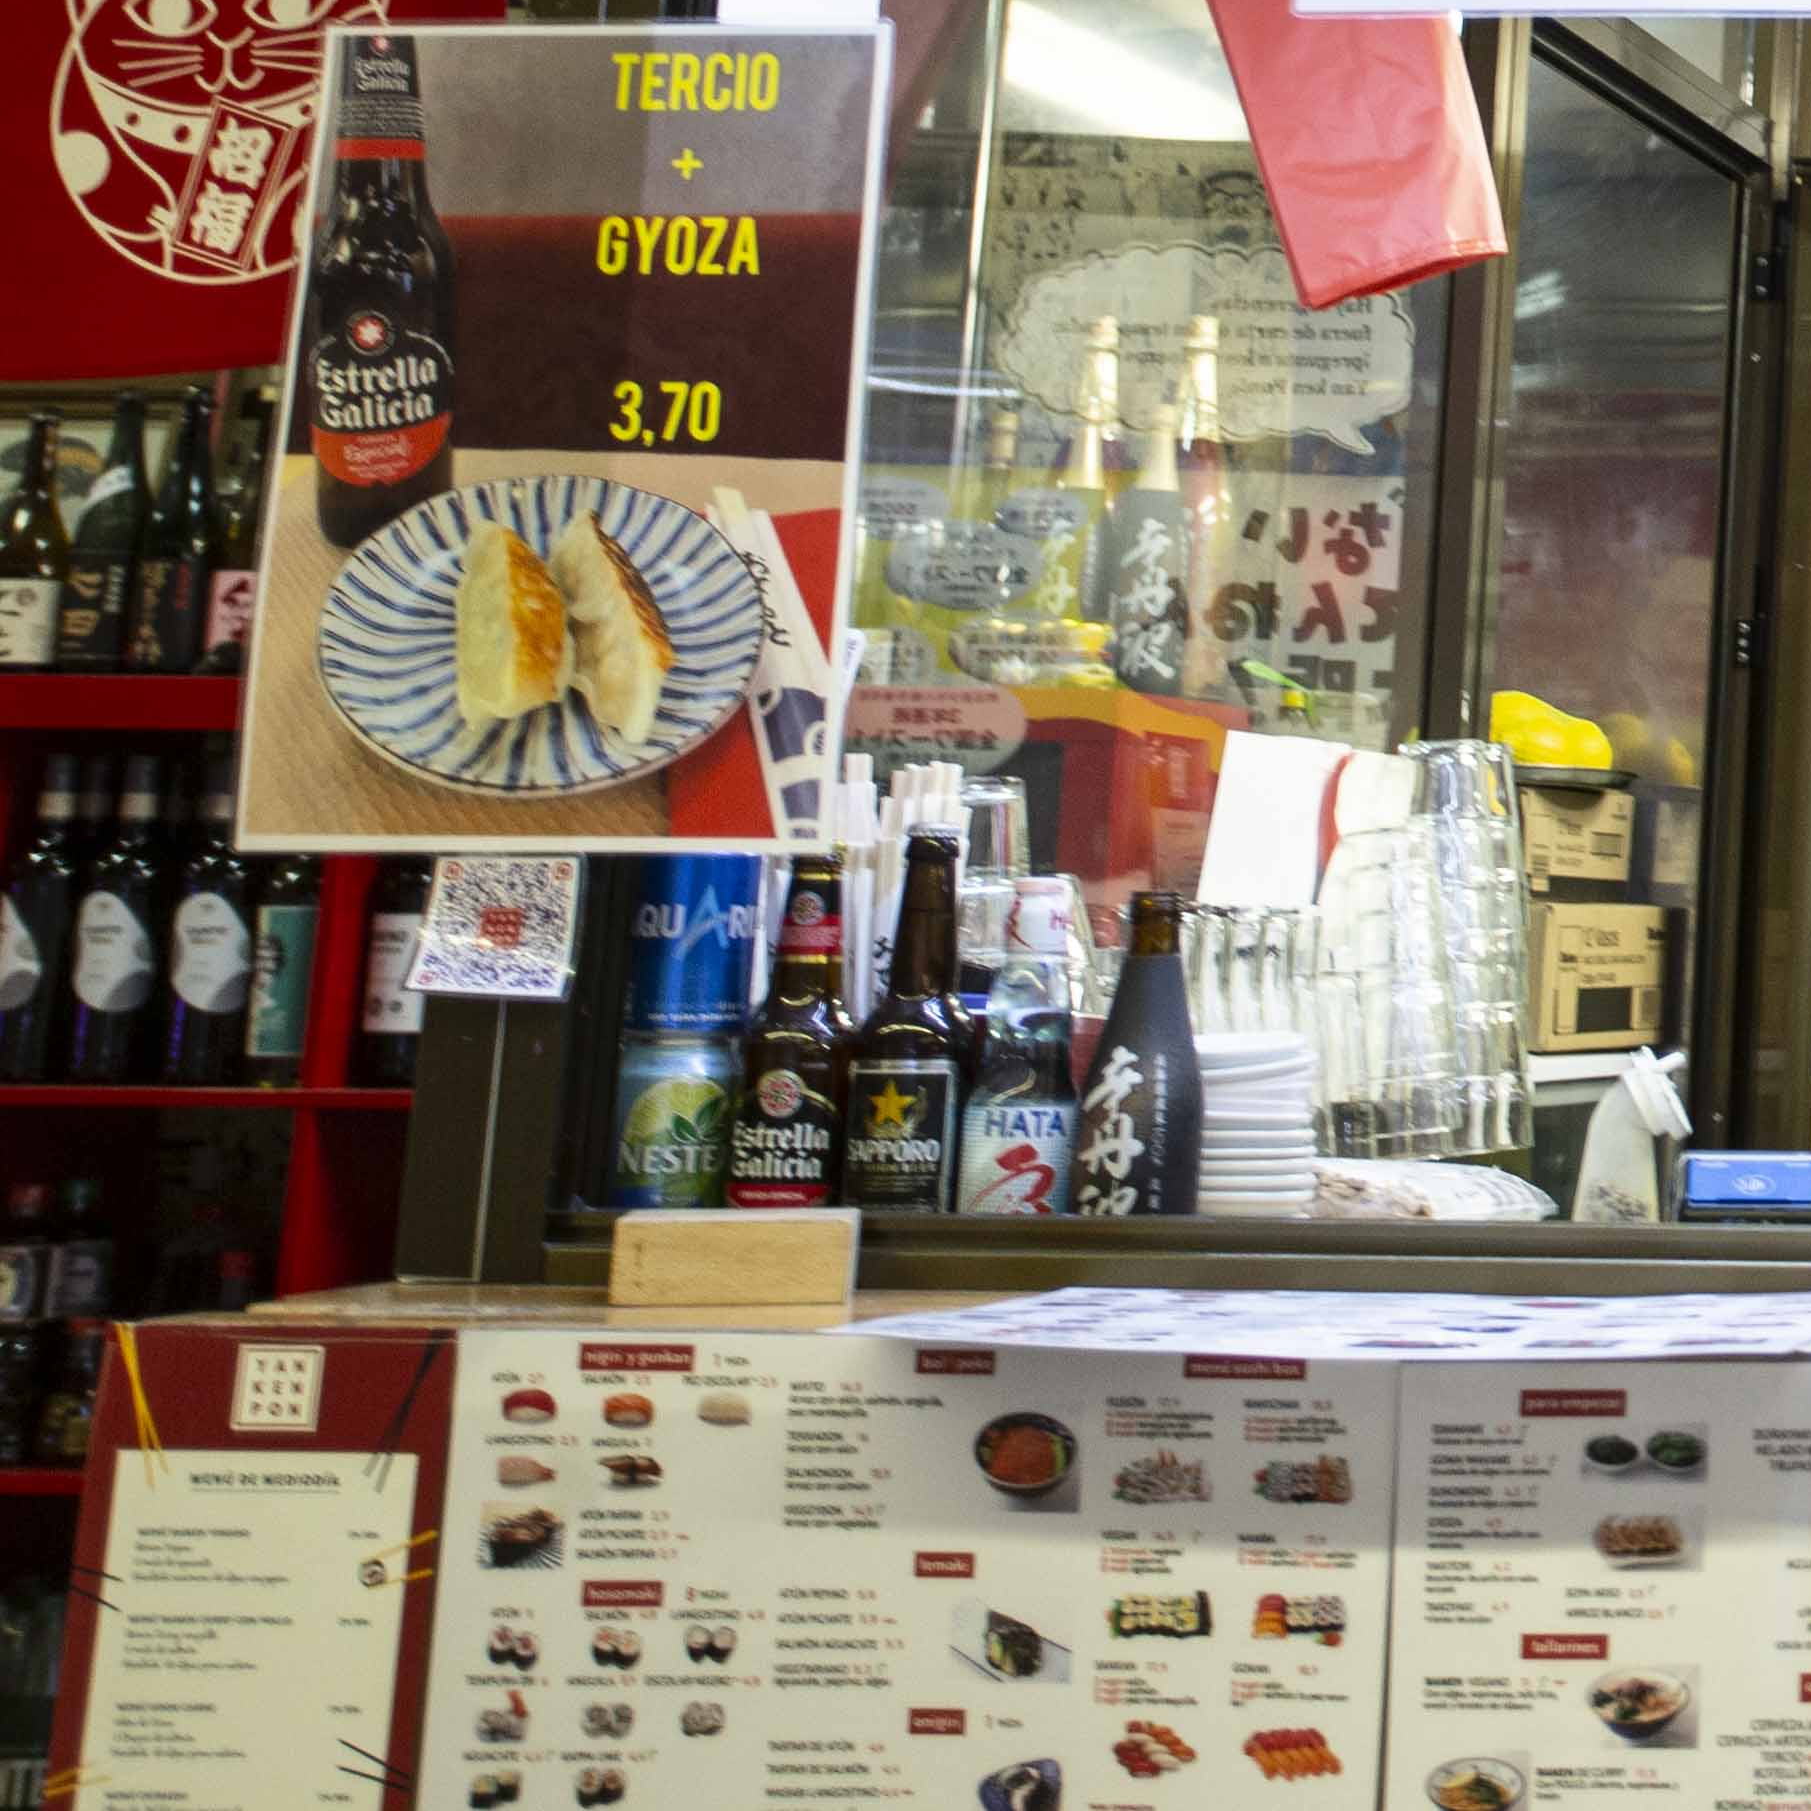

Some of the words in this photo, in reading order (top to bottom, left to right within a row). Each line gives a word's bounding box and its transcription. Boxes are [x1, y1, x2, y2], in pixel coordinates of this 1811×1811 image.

[613, 52, 780, 112] TERCIO
[596, 215, 760, 277] GYOZA
[317, 356, 438, 394] Estrella
[320, 392, 434, 430] Galicia
[609, 380, 722, 448] 3,70
[732, 1121, 830, 1150] Estrella
[617, 1143, 721, 1174] NESTE
[732, 1150, 822, 1179] Galicia
